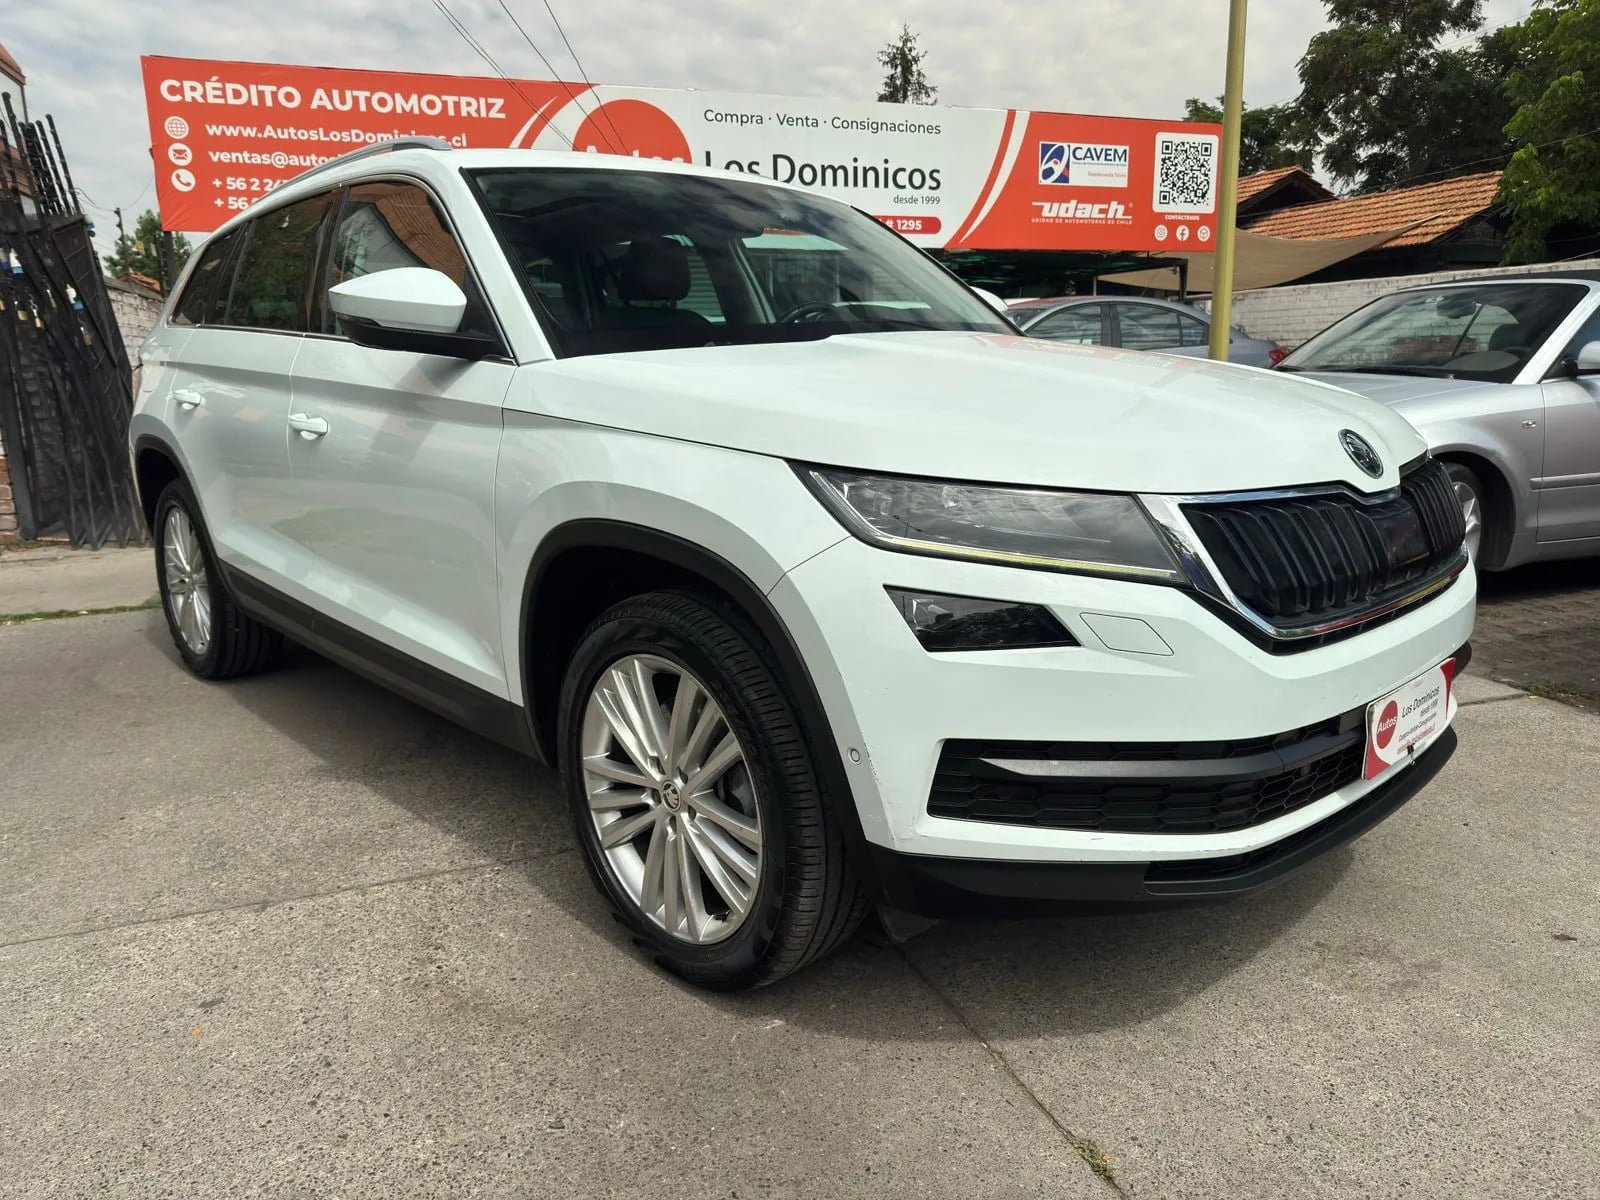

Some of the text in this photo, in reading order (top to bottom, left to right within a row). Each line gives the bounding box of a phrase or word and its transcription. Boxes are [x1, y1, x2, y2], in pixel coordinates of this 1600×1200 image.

[160, 76, 506, 119] CRÉDITO AUTOMOTRIZ
[704, 109, 942, 134] Compra Venta Consignaciones
[205, 124, 467, 147] www.AutosLosDomi.cl
[1072, 147, 1127, 162] CAVEM
[772, 153, 942, 191] Dominicos
[226, 177, 247, 190] 56
[250, 178, 261, 191] 2
[228, 197, 249, 210] 56
[893, 195, 941, 205] desde 1999
[1032, 199, 1132, 219] udach
[896, 219, 922, 230] 1295
[1377, 715, 1398, 734] Autos
